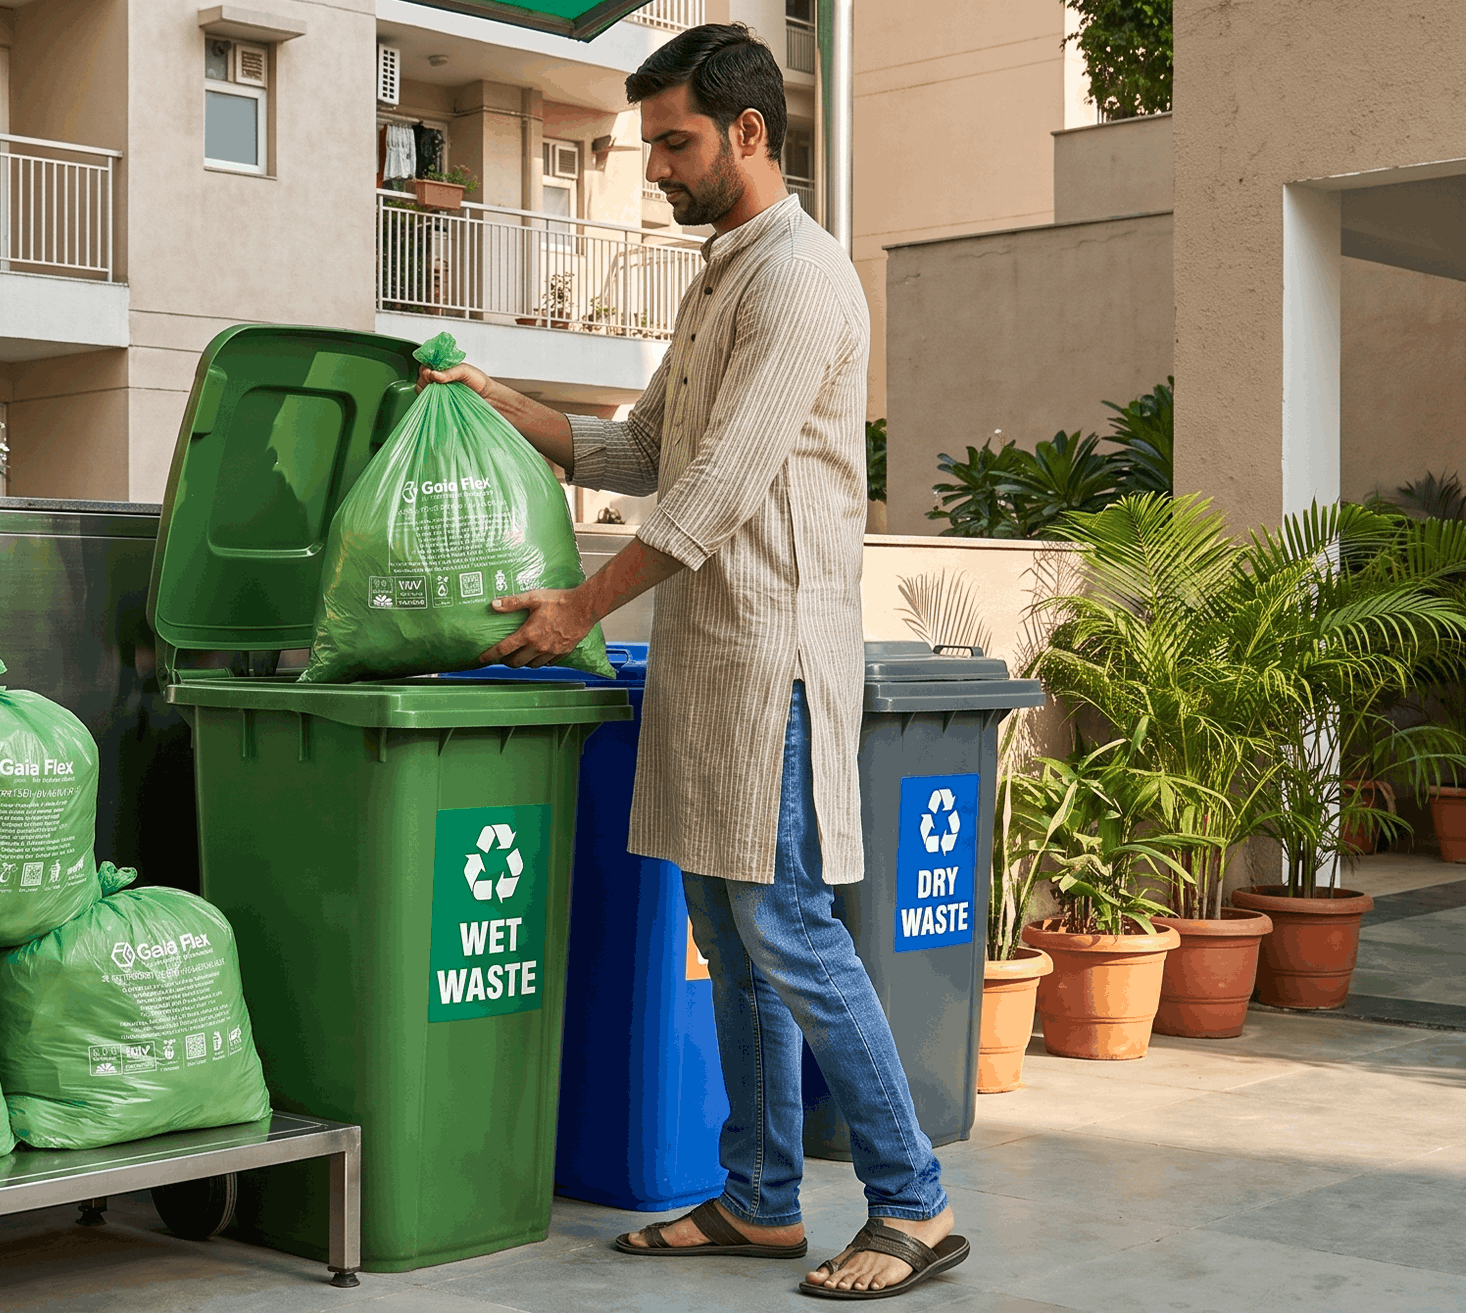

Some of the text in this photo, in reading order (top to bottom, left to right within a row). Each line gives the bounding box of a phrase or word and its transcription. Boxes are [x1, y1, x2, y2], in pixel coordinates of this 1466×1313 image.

[460, 476, 492, 492] Flex
[0, 758, 74, 777] Gaia Flex
[917, 866, 959, 899] DRY
[901, 901, 969, 938] WASTE
[180, 932, 211, 952] Flex
[459, 917, 523, 957] WET
[436, 960, 537, 1005] WASTE
